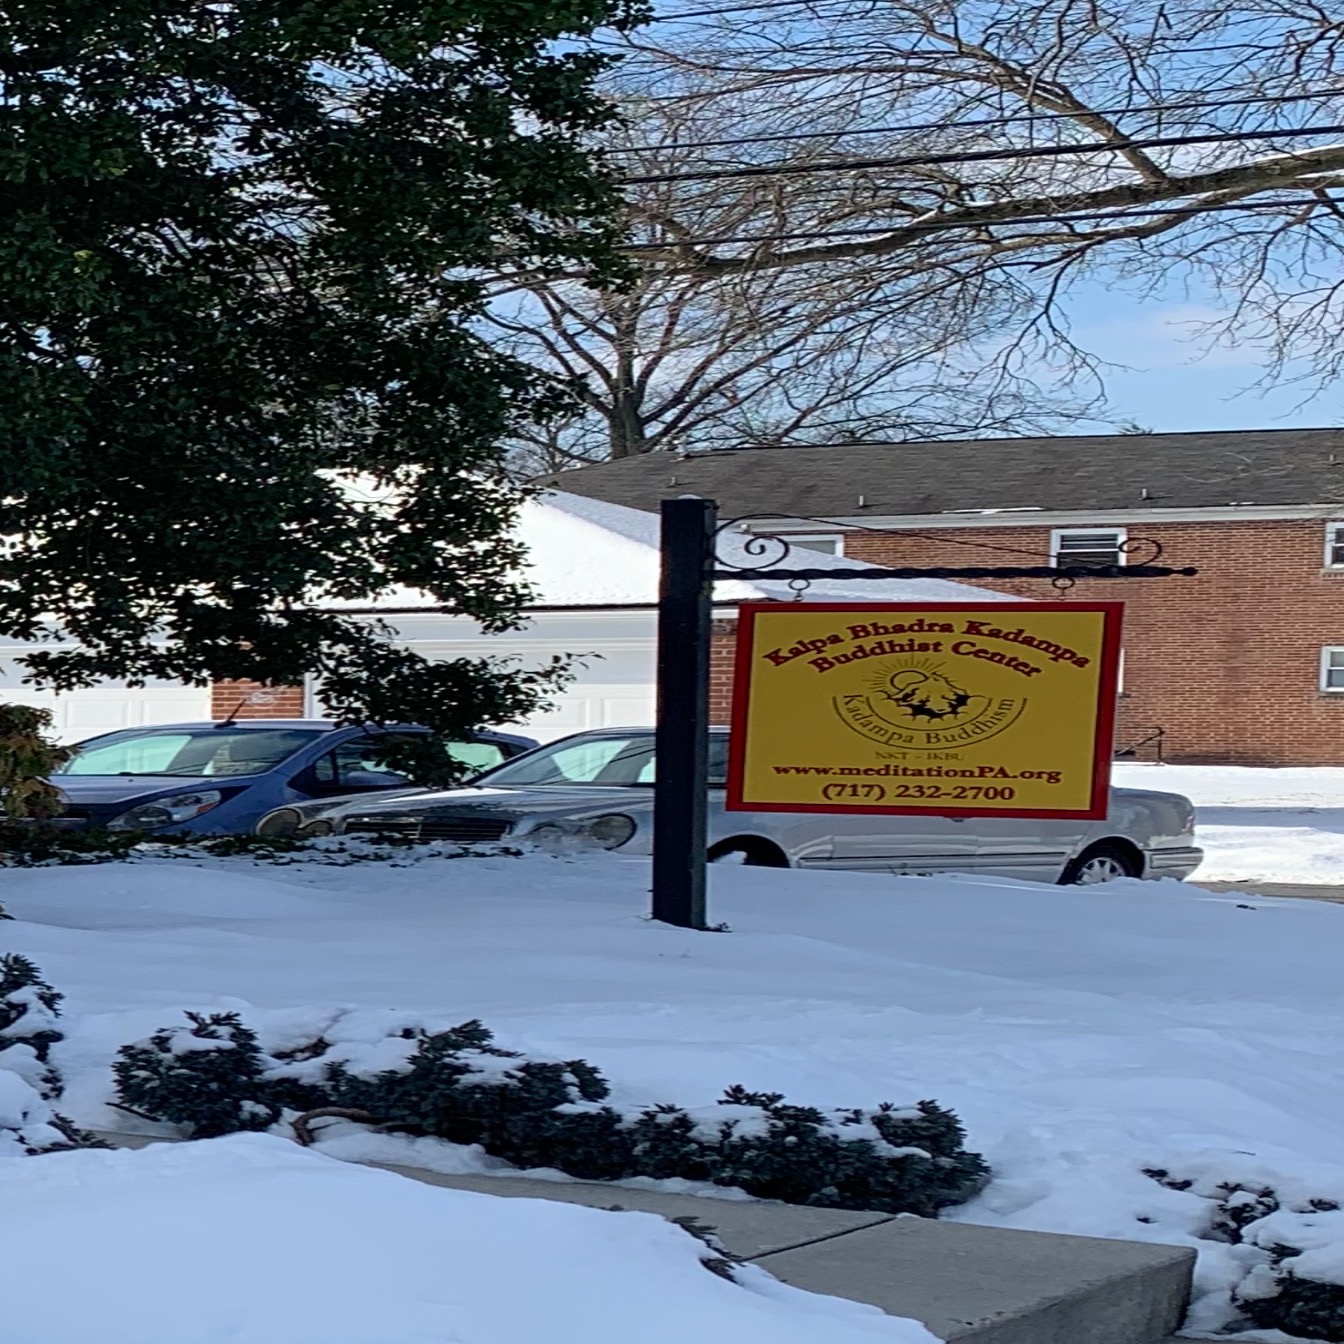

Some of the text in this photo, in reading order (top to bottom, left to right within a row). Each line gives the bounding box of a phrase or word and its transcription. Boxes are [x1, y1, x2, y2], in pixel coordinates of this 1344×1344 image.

[762, 619, 1091, 668] Kalpa Bhadra Kadampa
[807, 639, 1043, 678] Buddhist Center
[843, 694, 1015, 745] Kadampa Buddhism
[874, 751, 908, 760] NKT
[772, 764, 1062, 784] www.meditationPA.org
[821, 783, 1015, 802] (717) 232-2700
